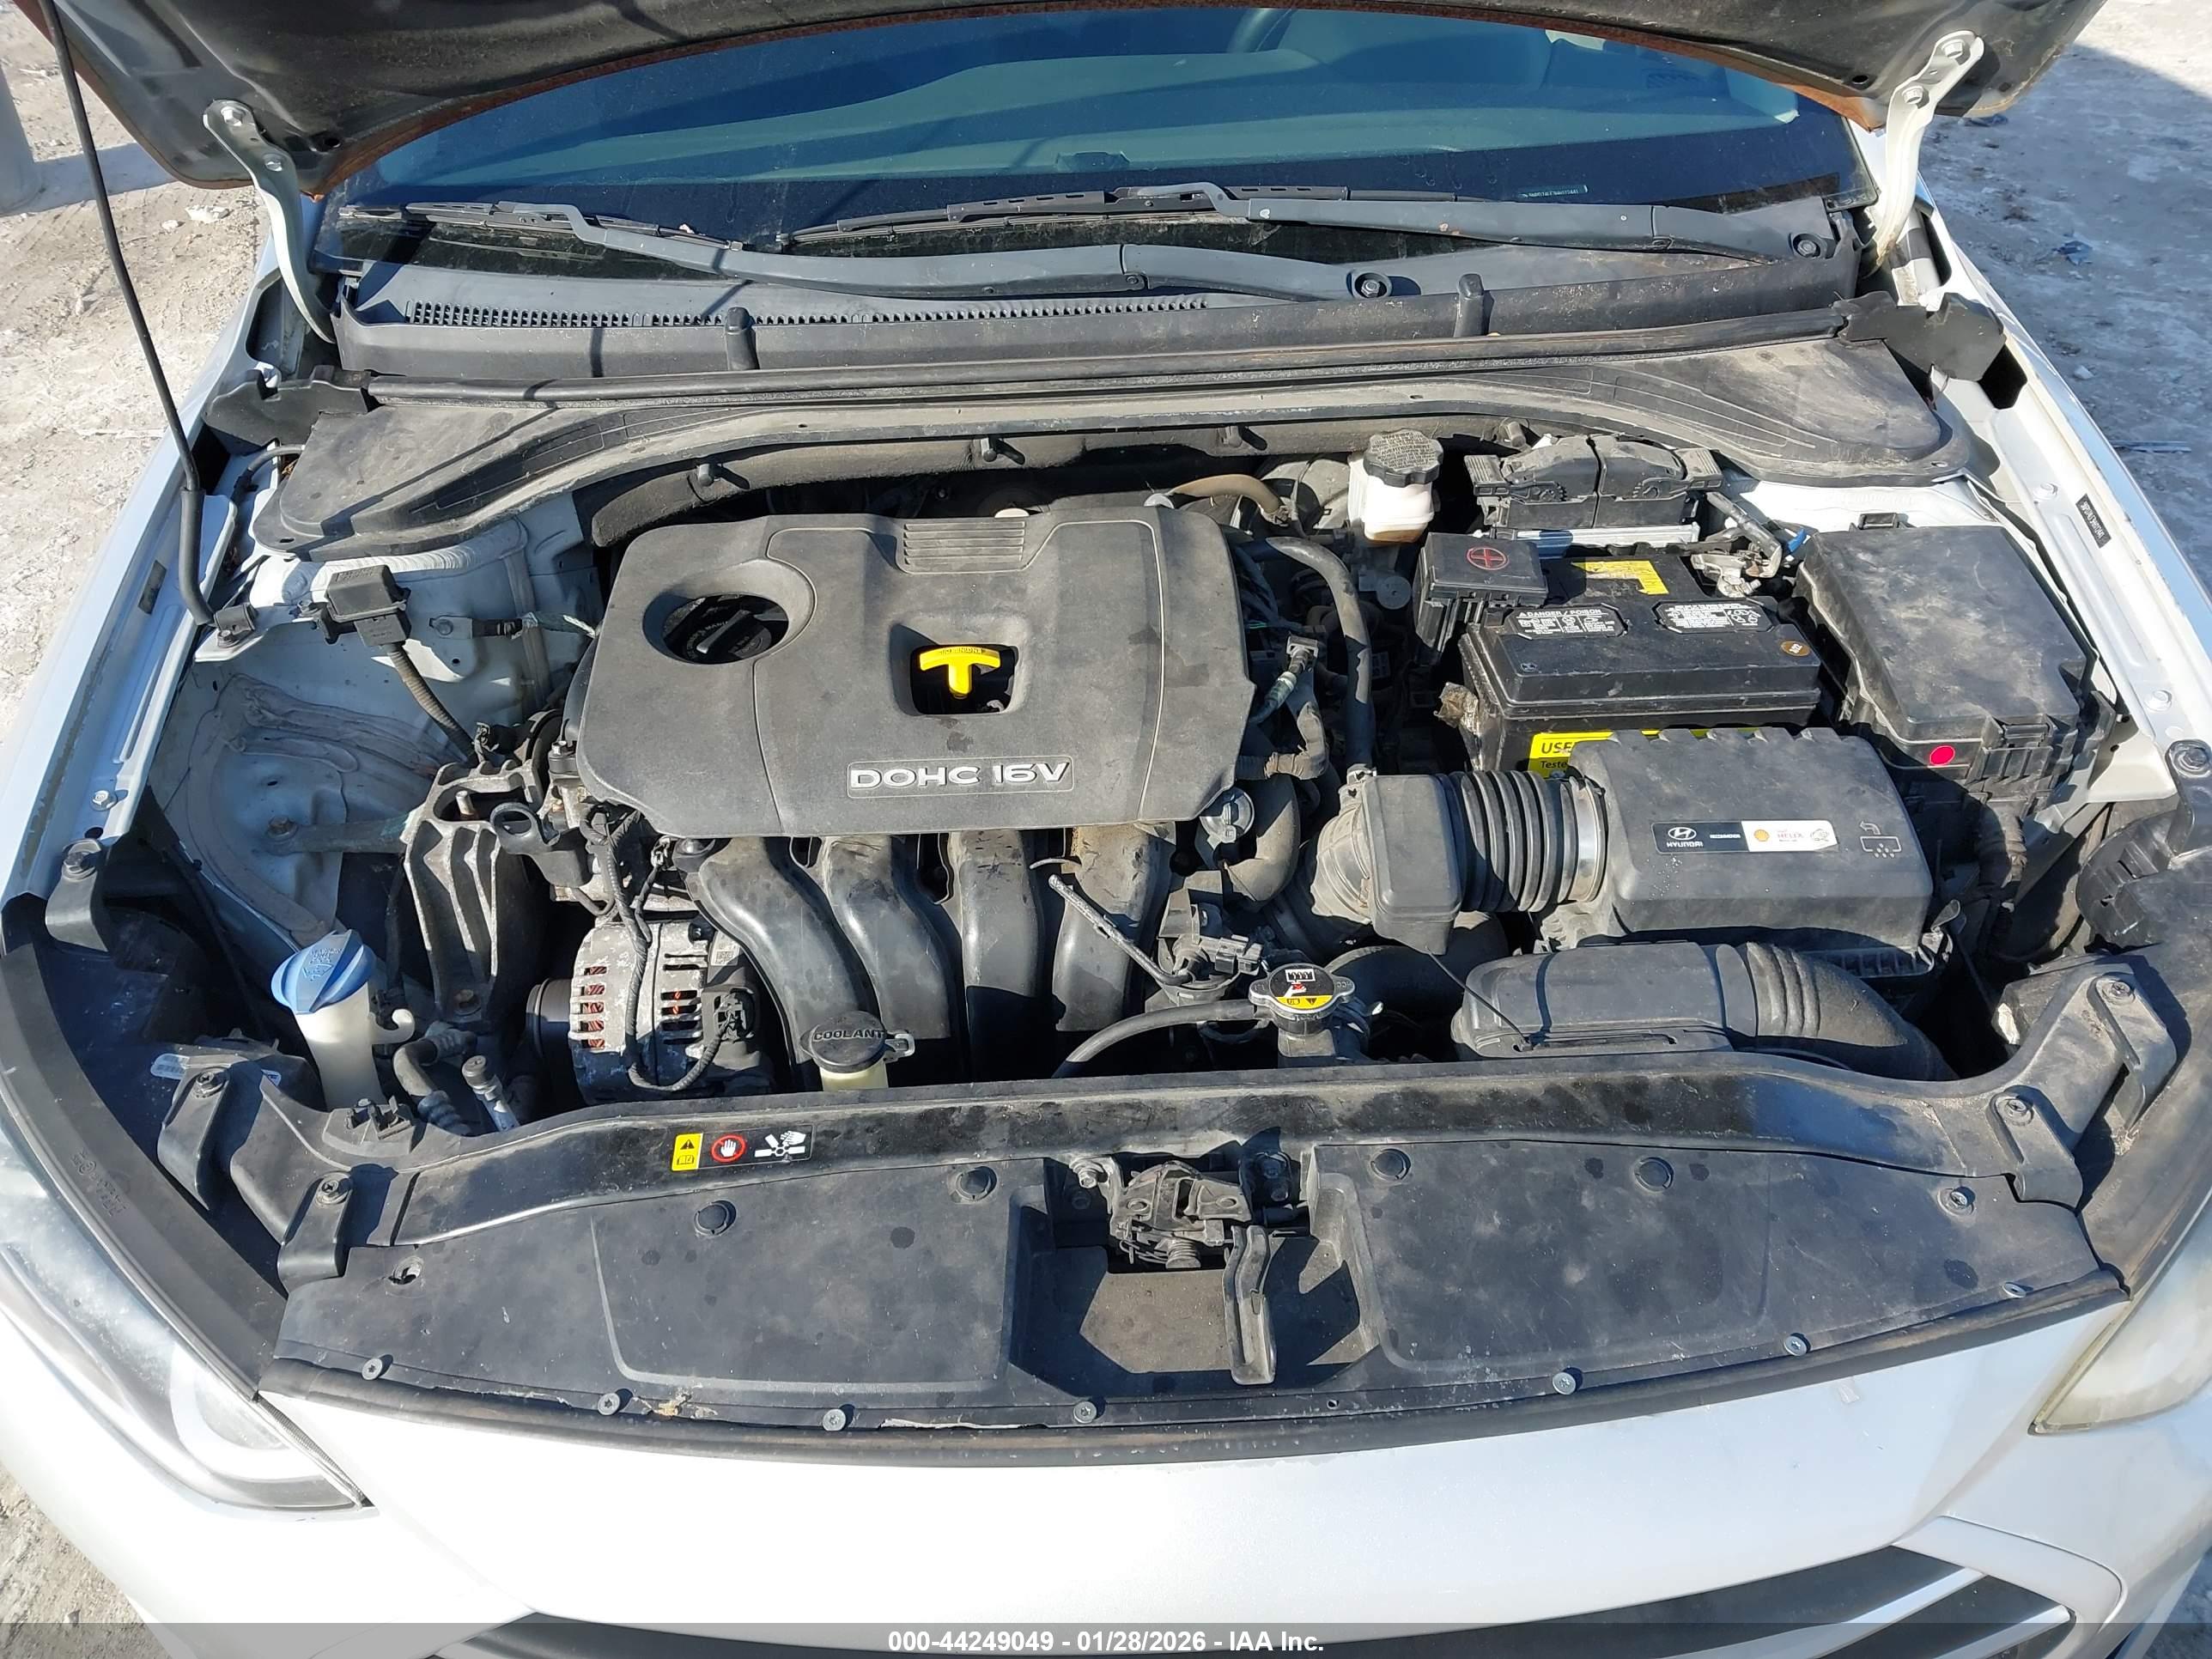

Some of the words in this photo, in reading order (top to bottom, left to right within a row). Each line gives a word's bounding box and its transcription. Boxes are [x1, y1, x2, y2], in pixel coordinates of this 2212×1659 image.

[850, 766, 981, 789] DOHC
[992, 761, 1070, 784] 16V
[813, 1030, 884, 1042] COOLANT
